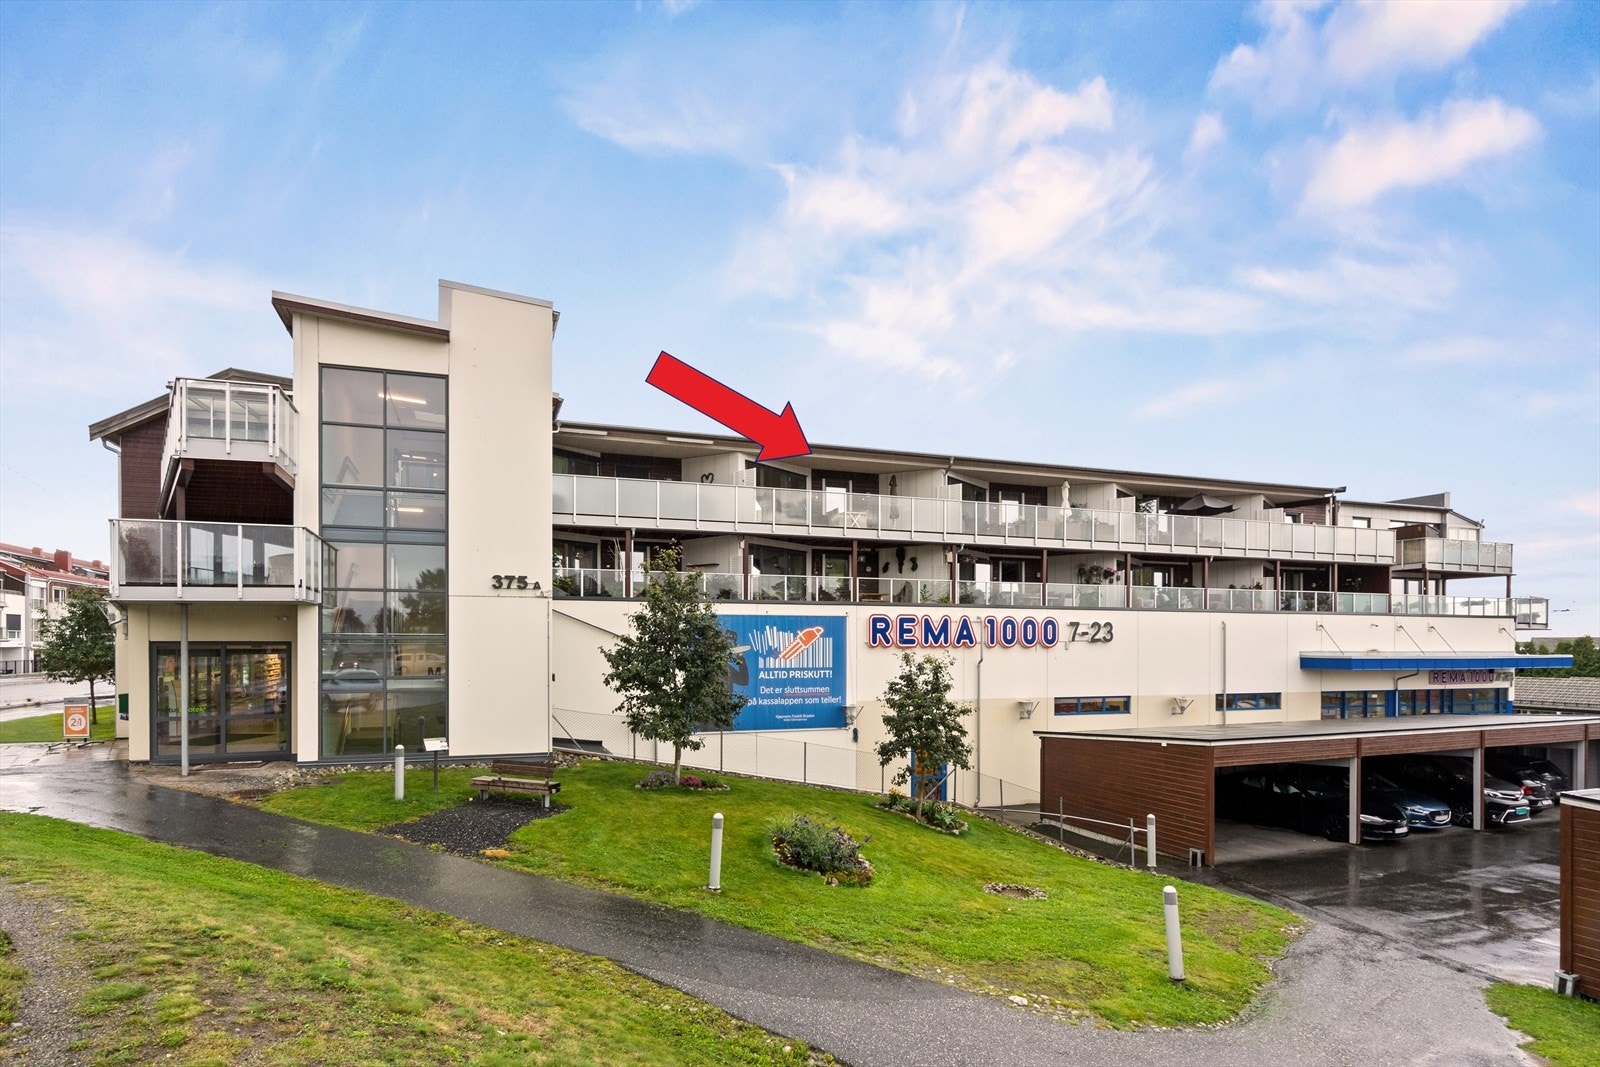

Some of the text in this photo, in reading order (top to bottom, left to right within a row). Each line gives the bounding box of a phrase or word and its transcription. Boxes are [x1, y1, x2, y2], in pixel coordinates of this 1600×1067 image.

[492, 575, 542, 590] 375 A
[869, 614, 1114, 649] REMA 1000 7-23
[759, 670, 833, 679] ALLTID PRISKUTT!
[1433, 672, 1466, 684] REMA
[1470, 672, 1494, 683] 1000
[760, 686, 773, 694] Det
[784, 685, 830, 694] sluttsummen
[748, 698, 757, 706] på
[758, 697, 804, 706] kassalappen
[821, 696, 842, 704] teller!
